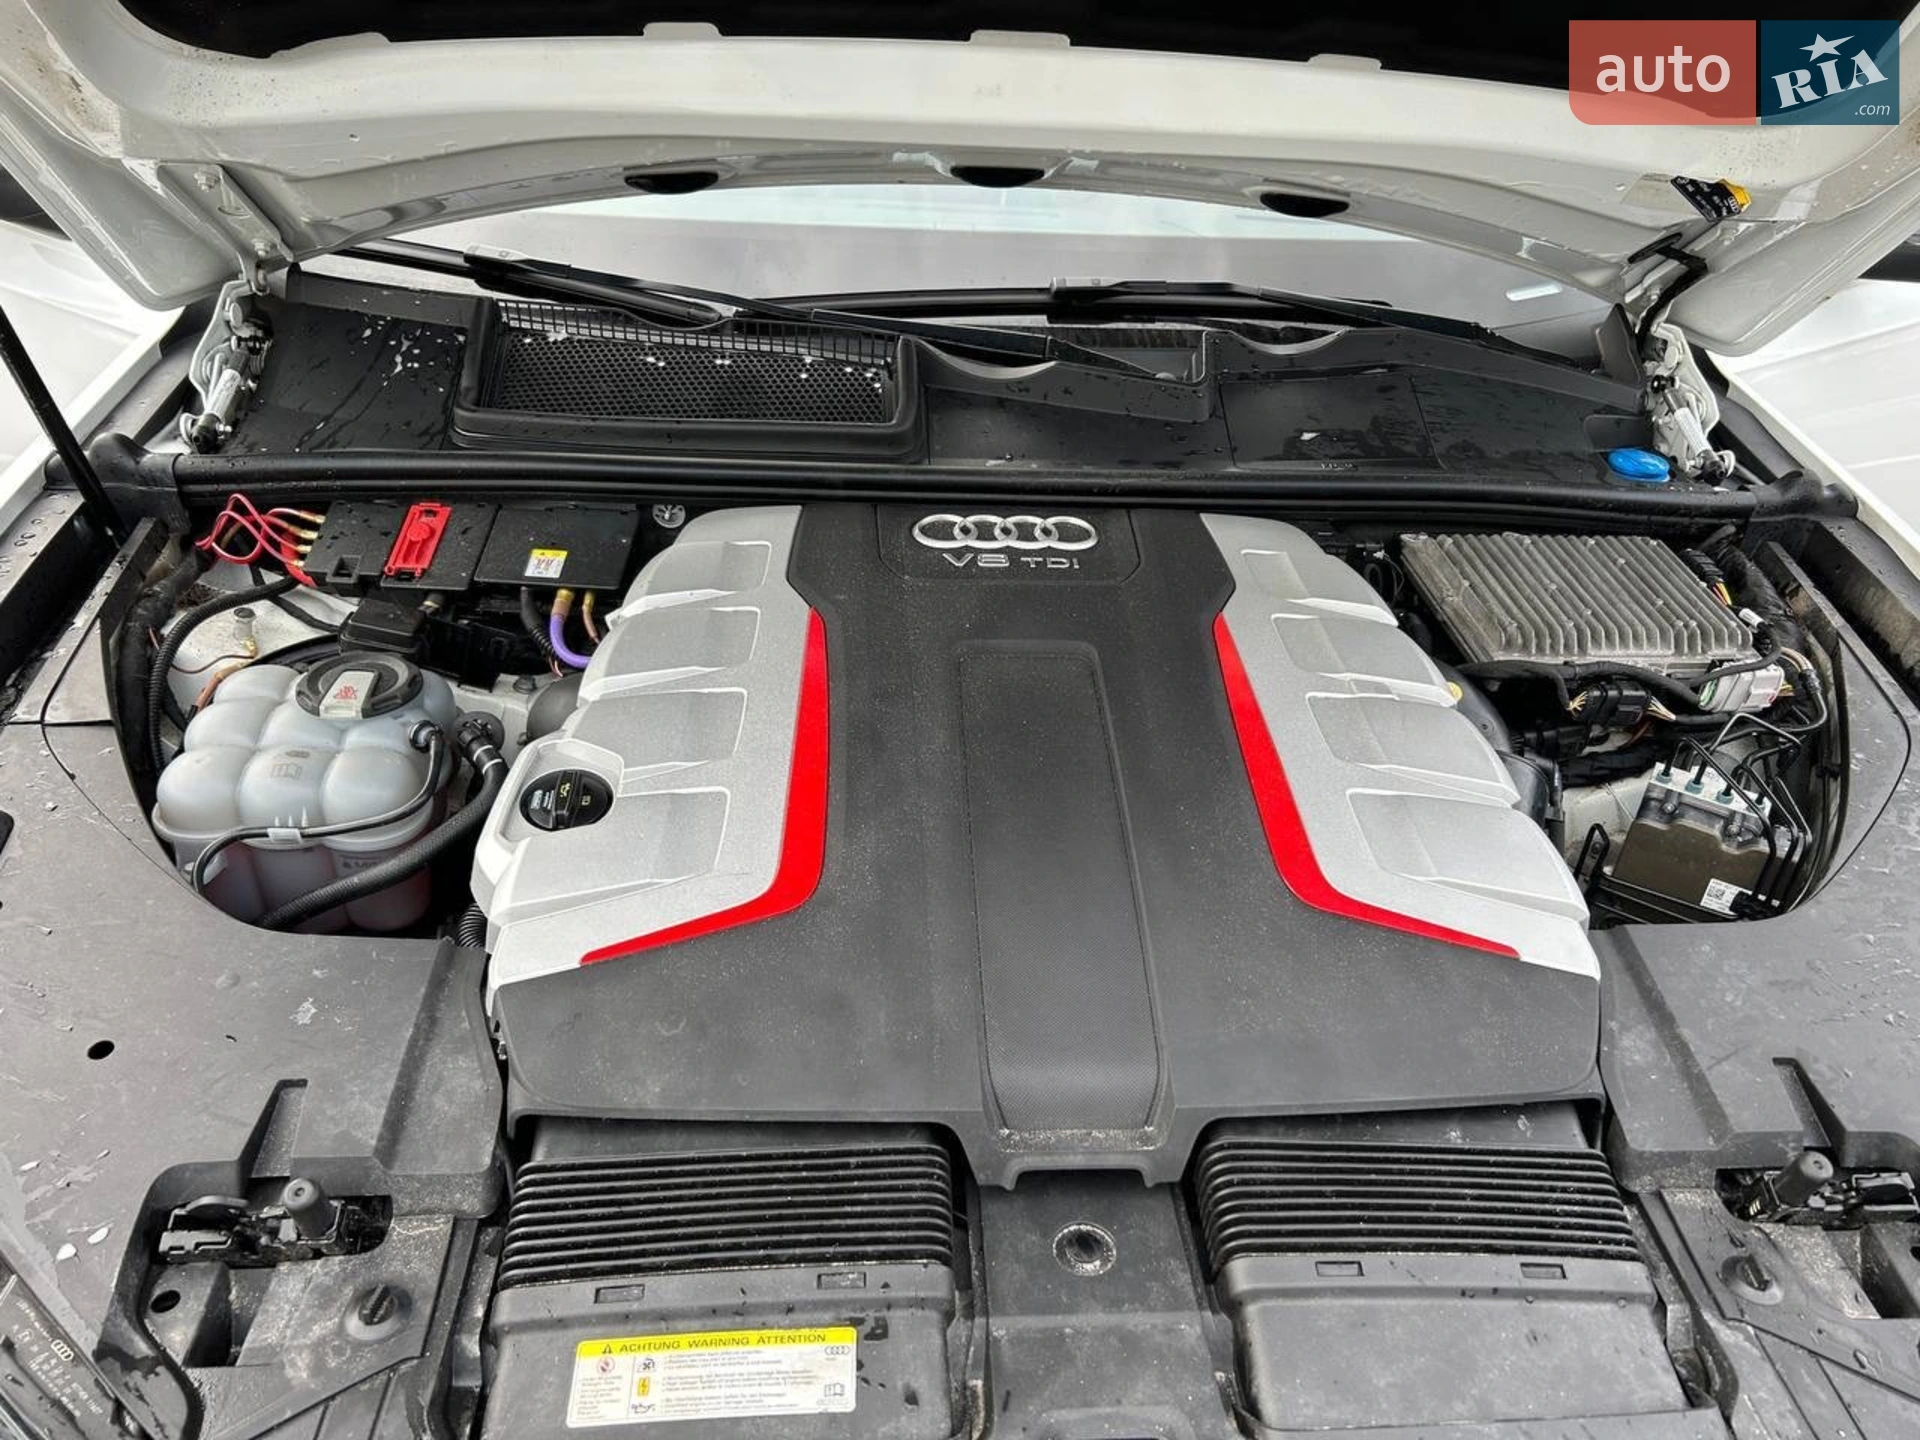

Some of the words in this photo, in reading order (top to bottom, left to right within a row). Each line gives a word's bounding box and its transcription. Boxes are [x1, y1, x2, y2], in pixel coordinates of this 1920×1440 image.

[942, 553, 1010, 568] V8
[1020, 556, 1081, 570] TDI
[619, 1340, 681, 1353] ACHTUNG
[688, 1336, 750, 1348] WARNING
[757, 1333, 827, 1346] ATTENTION
